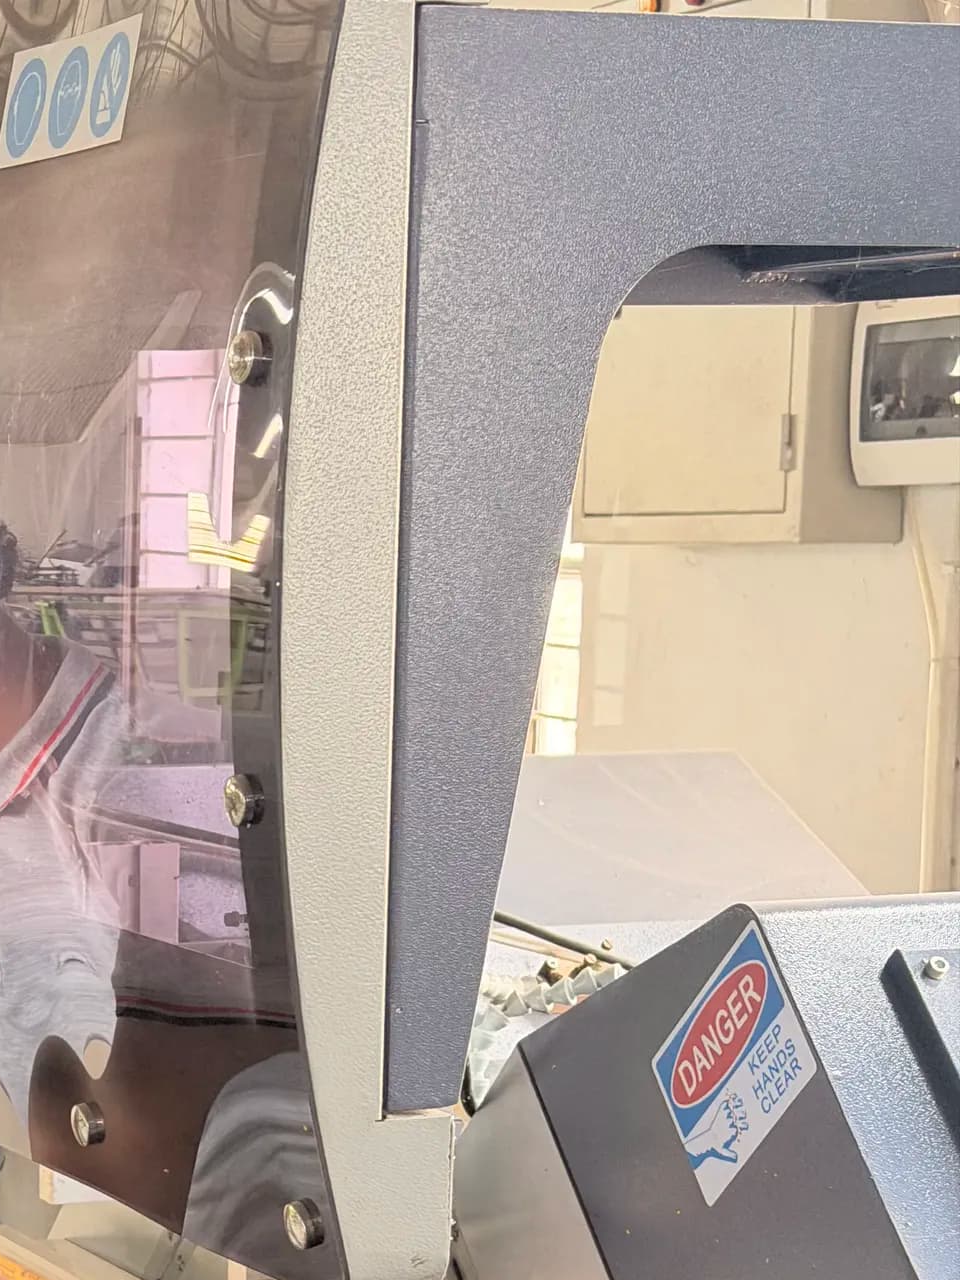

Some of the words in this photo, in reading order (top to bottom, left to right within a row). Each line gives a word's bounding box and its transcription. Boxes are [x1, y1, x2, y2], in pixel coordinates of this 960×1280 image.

[677, 974, 761, 1097] DANGER
[748, 1024, 782, 1075] KEEP
[752, 1038, 796, 1100] HANDS
[760, 1058, 802, 1114] CLEAR
